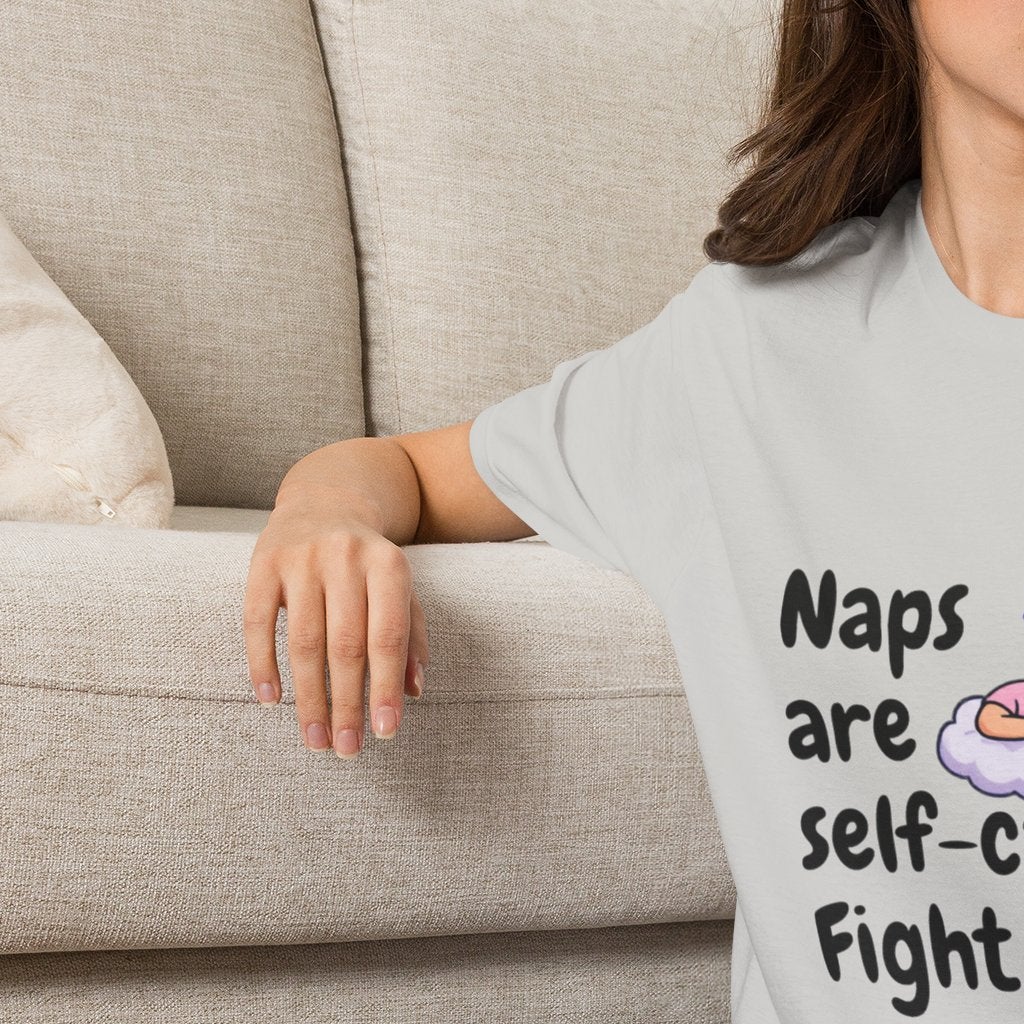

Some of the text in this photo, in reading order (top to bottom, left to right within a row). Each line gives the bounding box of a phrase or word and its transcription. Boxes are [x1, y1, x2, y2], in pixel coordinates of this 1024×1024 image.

[779, 568, 970, 680] Naps
[784, 698, 918, 764] are
[814, 901, 1022, 1018] Fight
